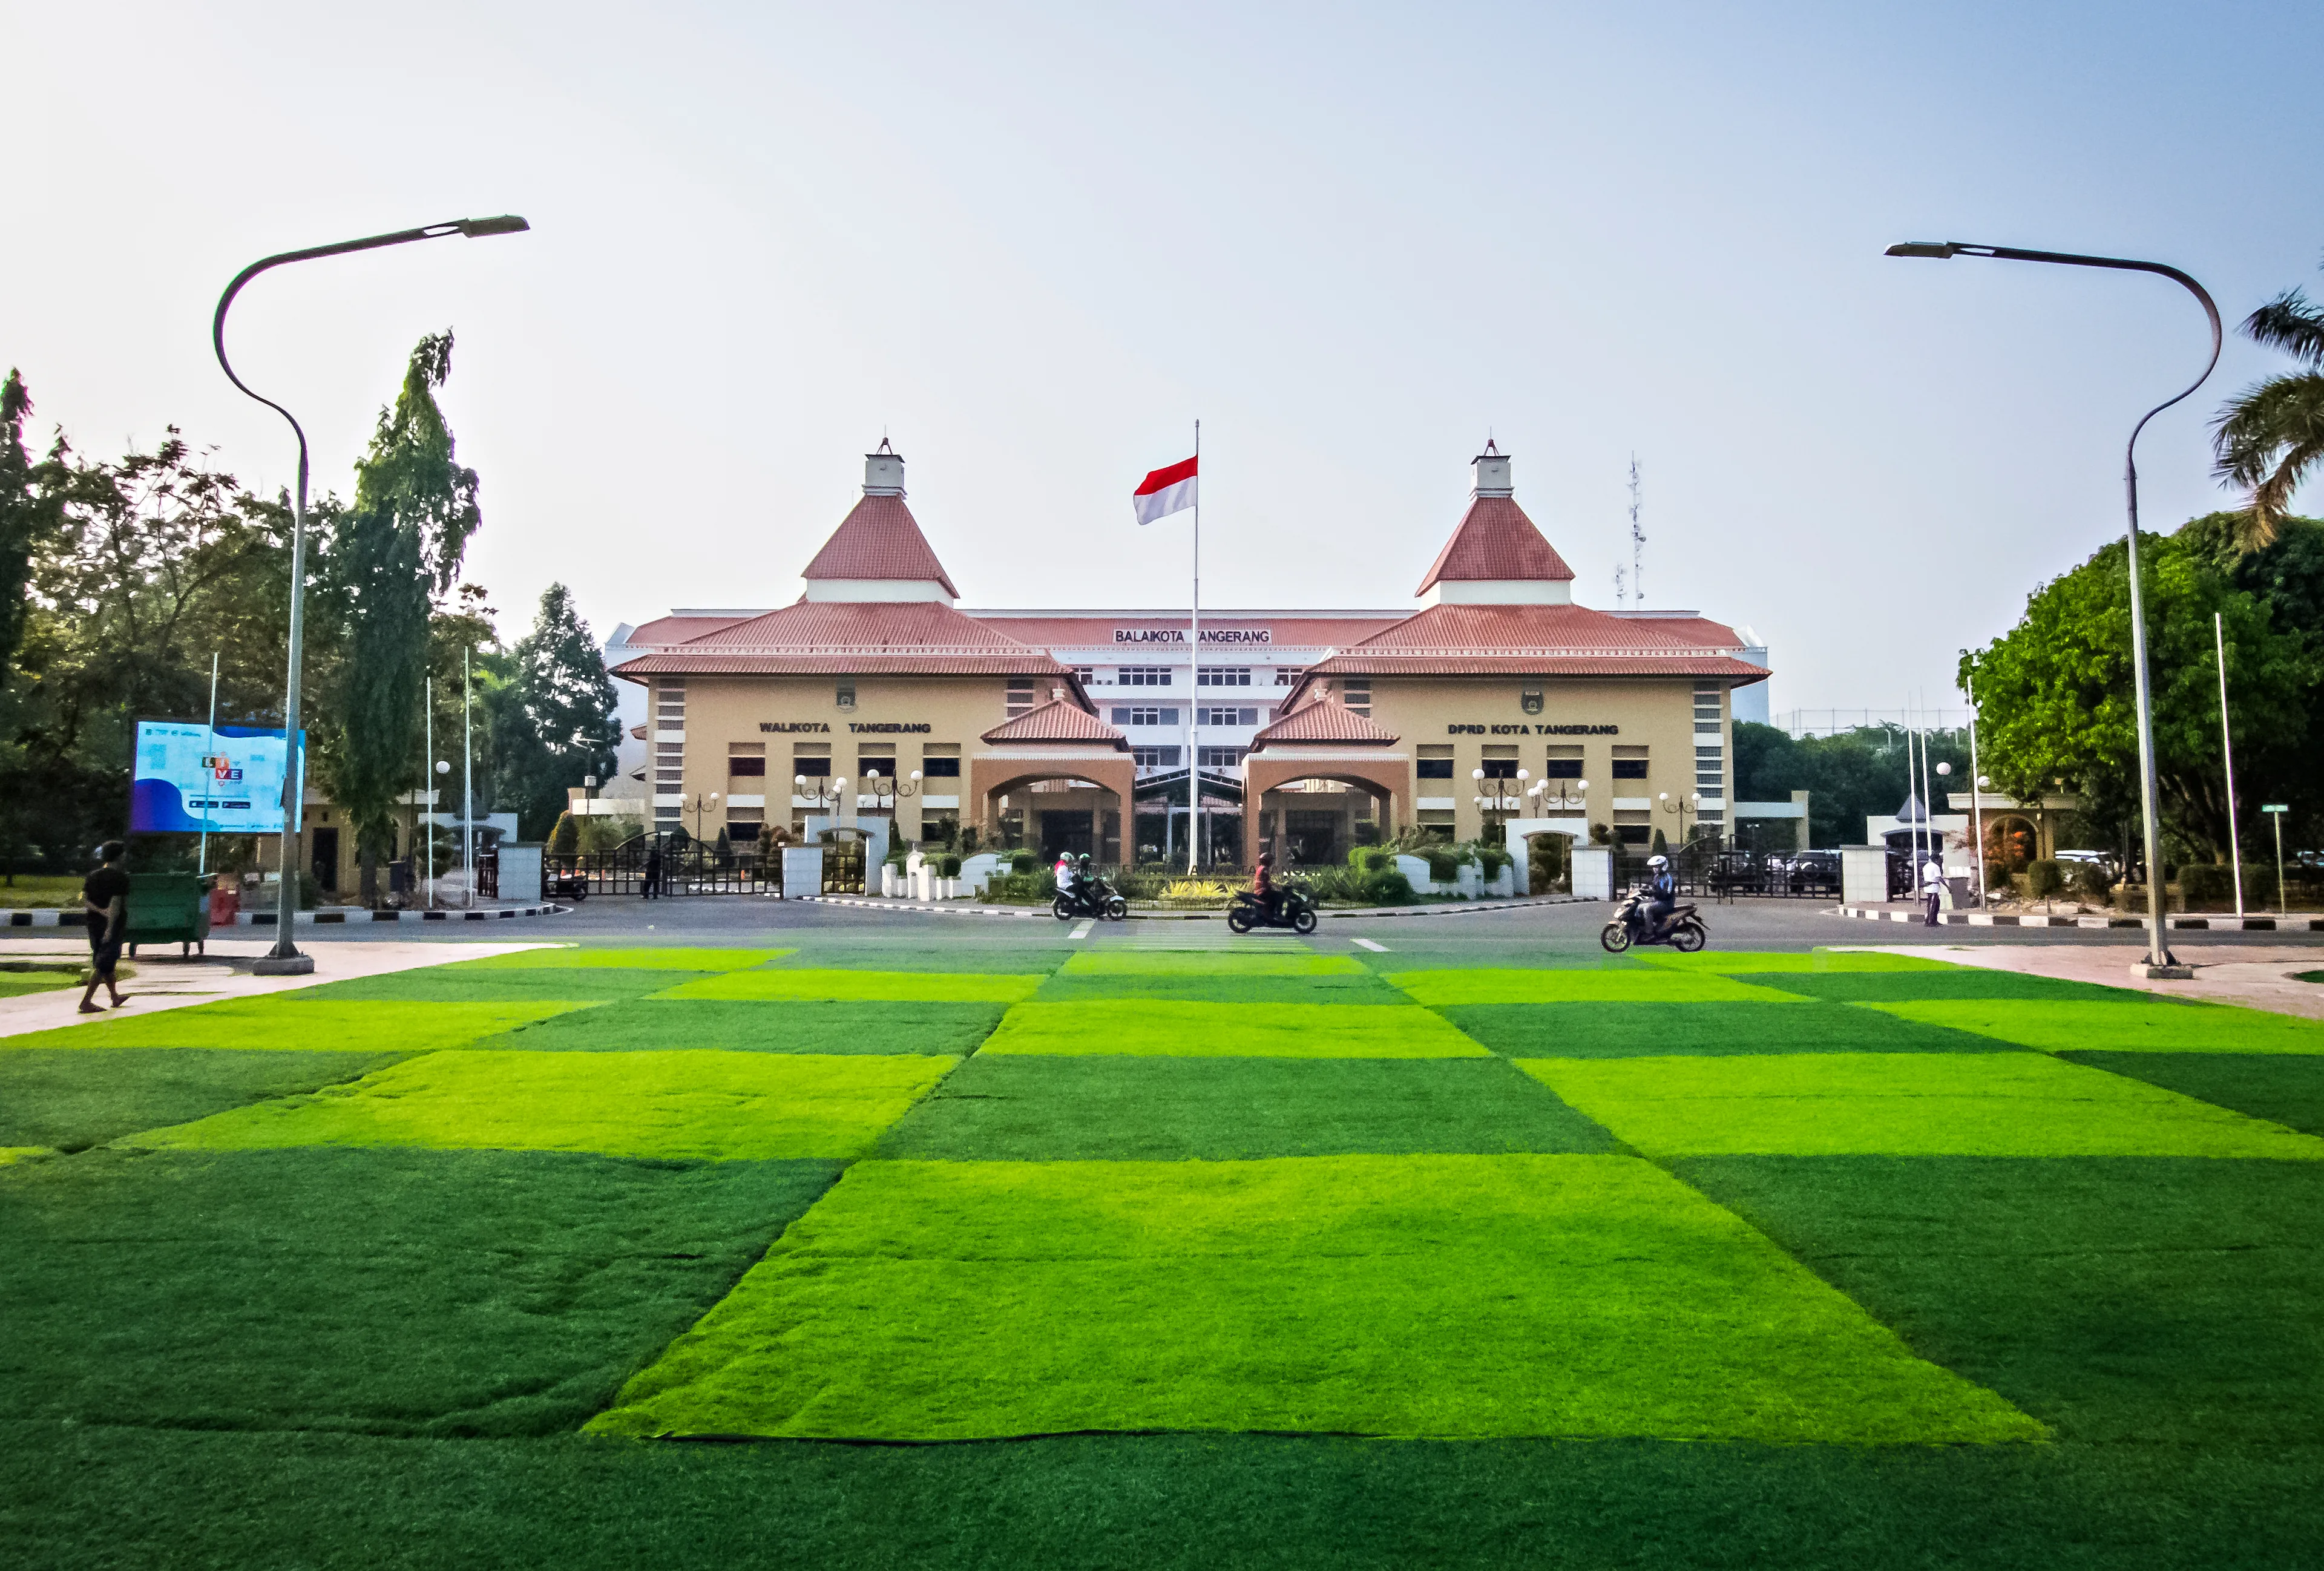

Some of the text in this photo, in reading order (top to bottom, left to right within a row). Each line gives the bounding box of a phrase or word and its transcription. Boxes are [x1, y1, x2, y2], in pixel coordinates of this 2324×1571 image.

[1115, 631, 1270, 642] BALAIKOTA ANGERANG
[760, 723, 931, 733] WALIKOTA TANGERANG
[1448, 724, 1618, 734] DPRD KOTA TANGERANG
